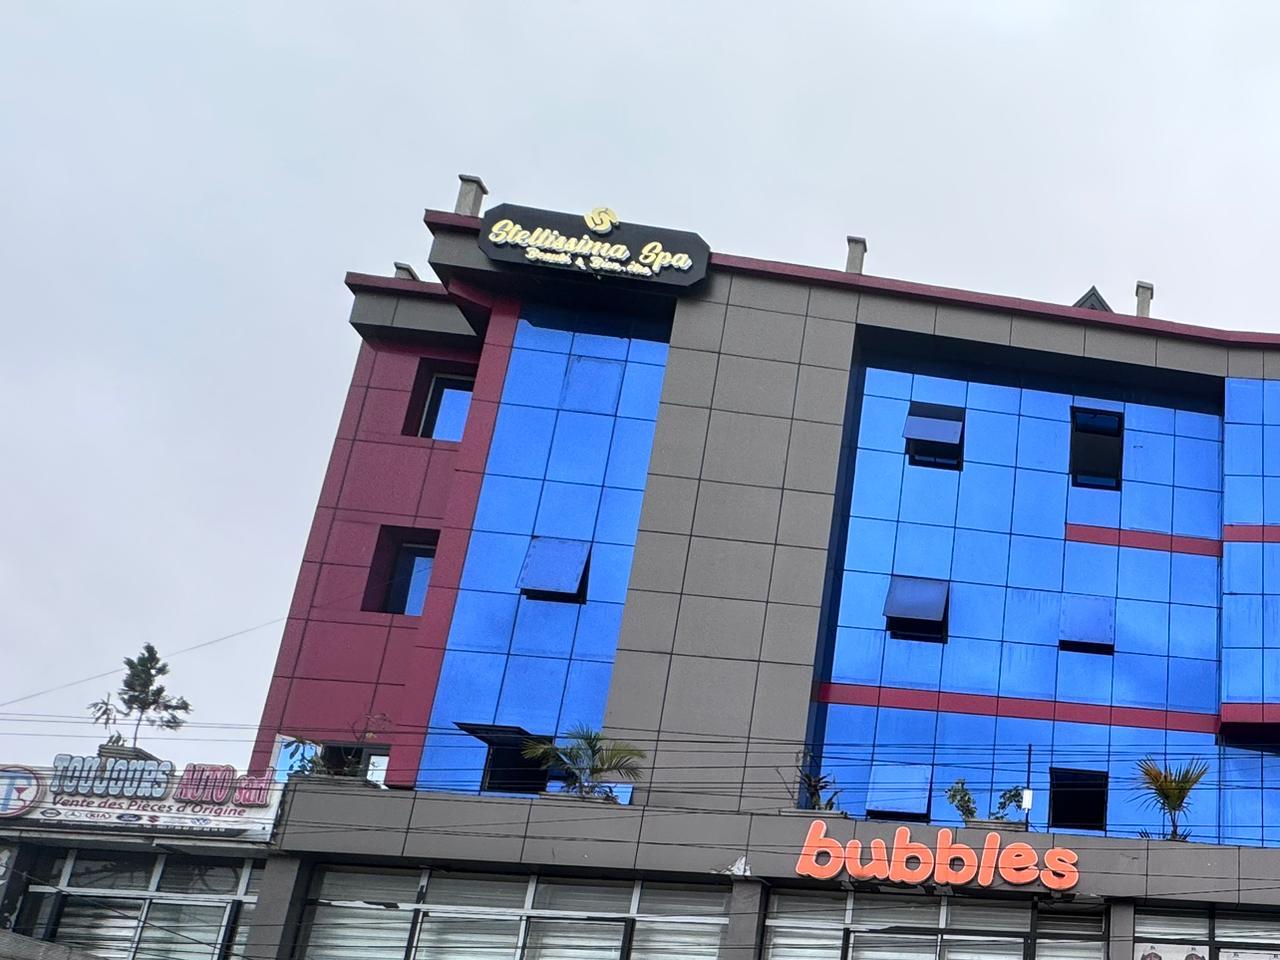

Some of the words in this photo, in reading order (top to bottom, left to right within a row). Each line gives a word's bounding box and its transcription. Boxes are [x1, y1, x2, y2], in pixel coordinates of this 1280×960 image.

[488, 219, 630, 261] Stellissima
[639, 241, 692, 274] Spa
[50, 754, 173, 798] TOUJOURS
[174, 764, 236, 803] AUTO
[53, 797, 94, 808] Vente
[98, 799, 123, 809] des
[126, 800, 172, 812] Pièces
[176, 803, 245, 817] d'Origine
[795, 819, 1079, 890] bubbles
